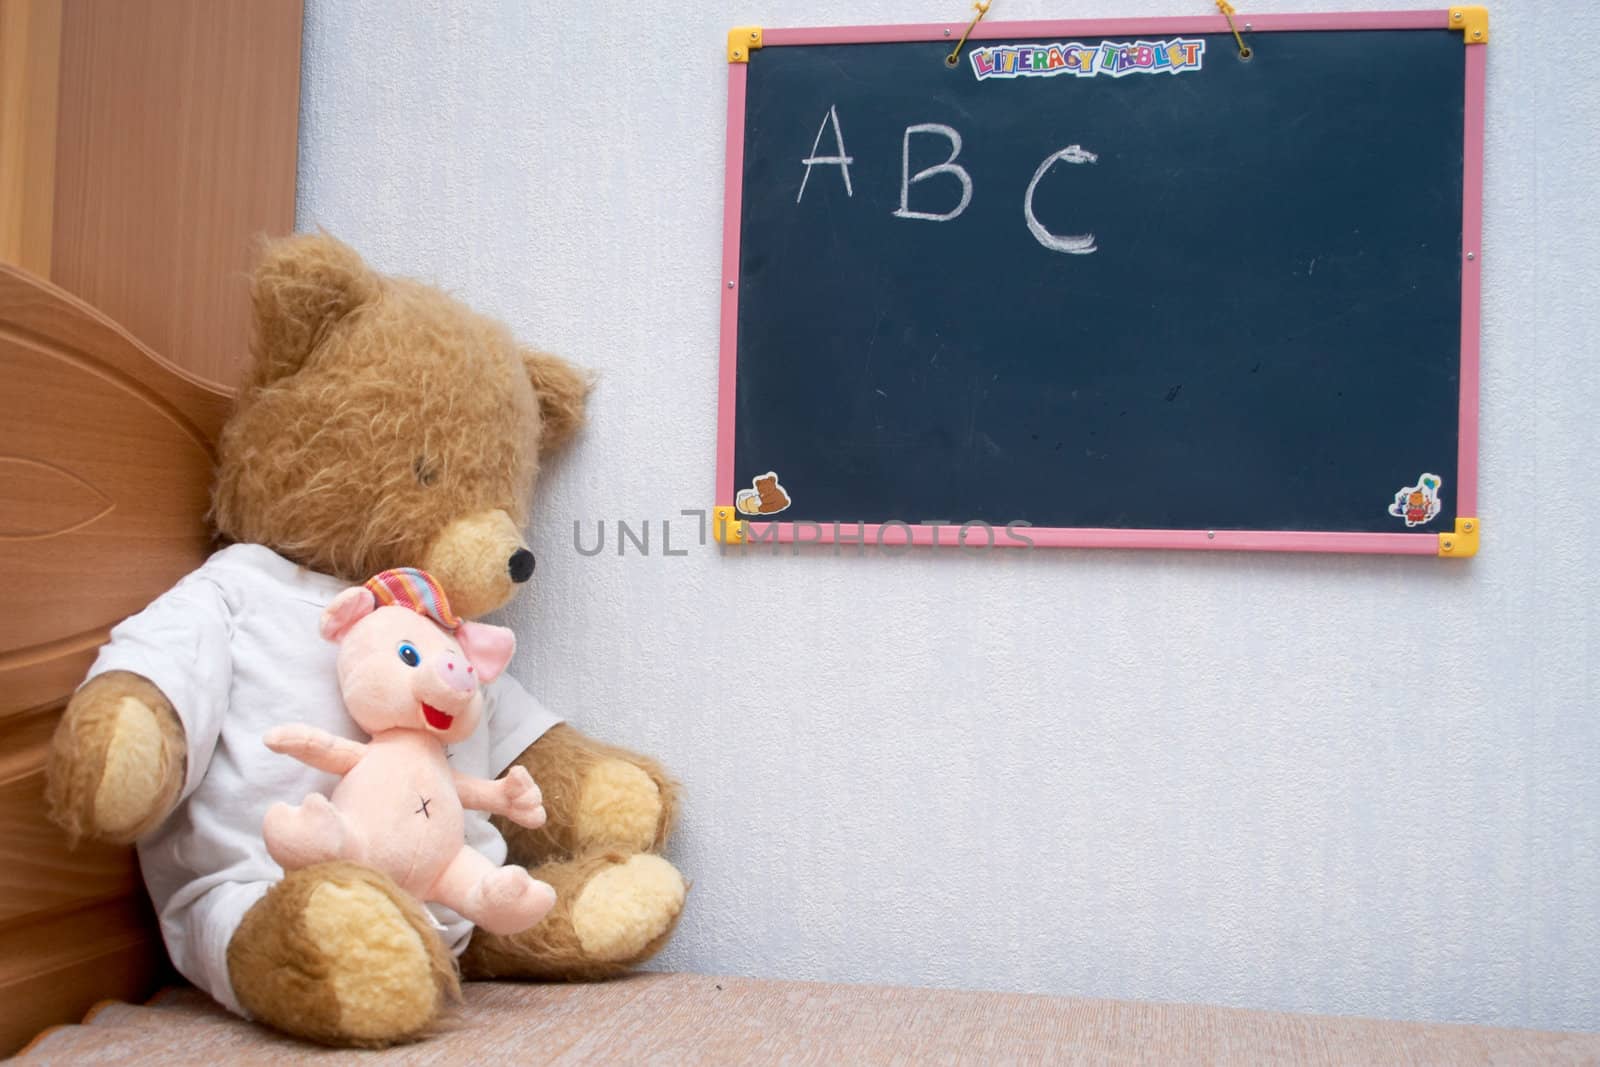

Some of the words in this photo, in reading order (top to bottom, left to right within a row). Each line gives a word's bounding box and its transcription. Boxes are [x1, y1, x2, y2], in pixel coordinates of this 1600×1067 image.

[973, 46, 1096, 75] LITERACY
[1101, 42, 1201, 73] TABLET
[797, 104, 853, 203] A
[891, 123, 973, 221] B
[1024, 144, 1098, 254] C
